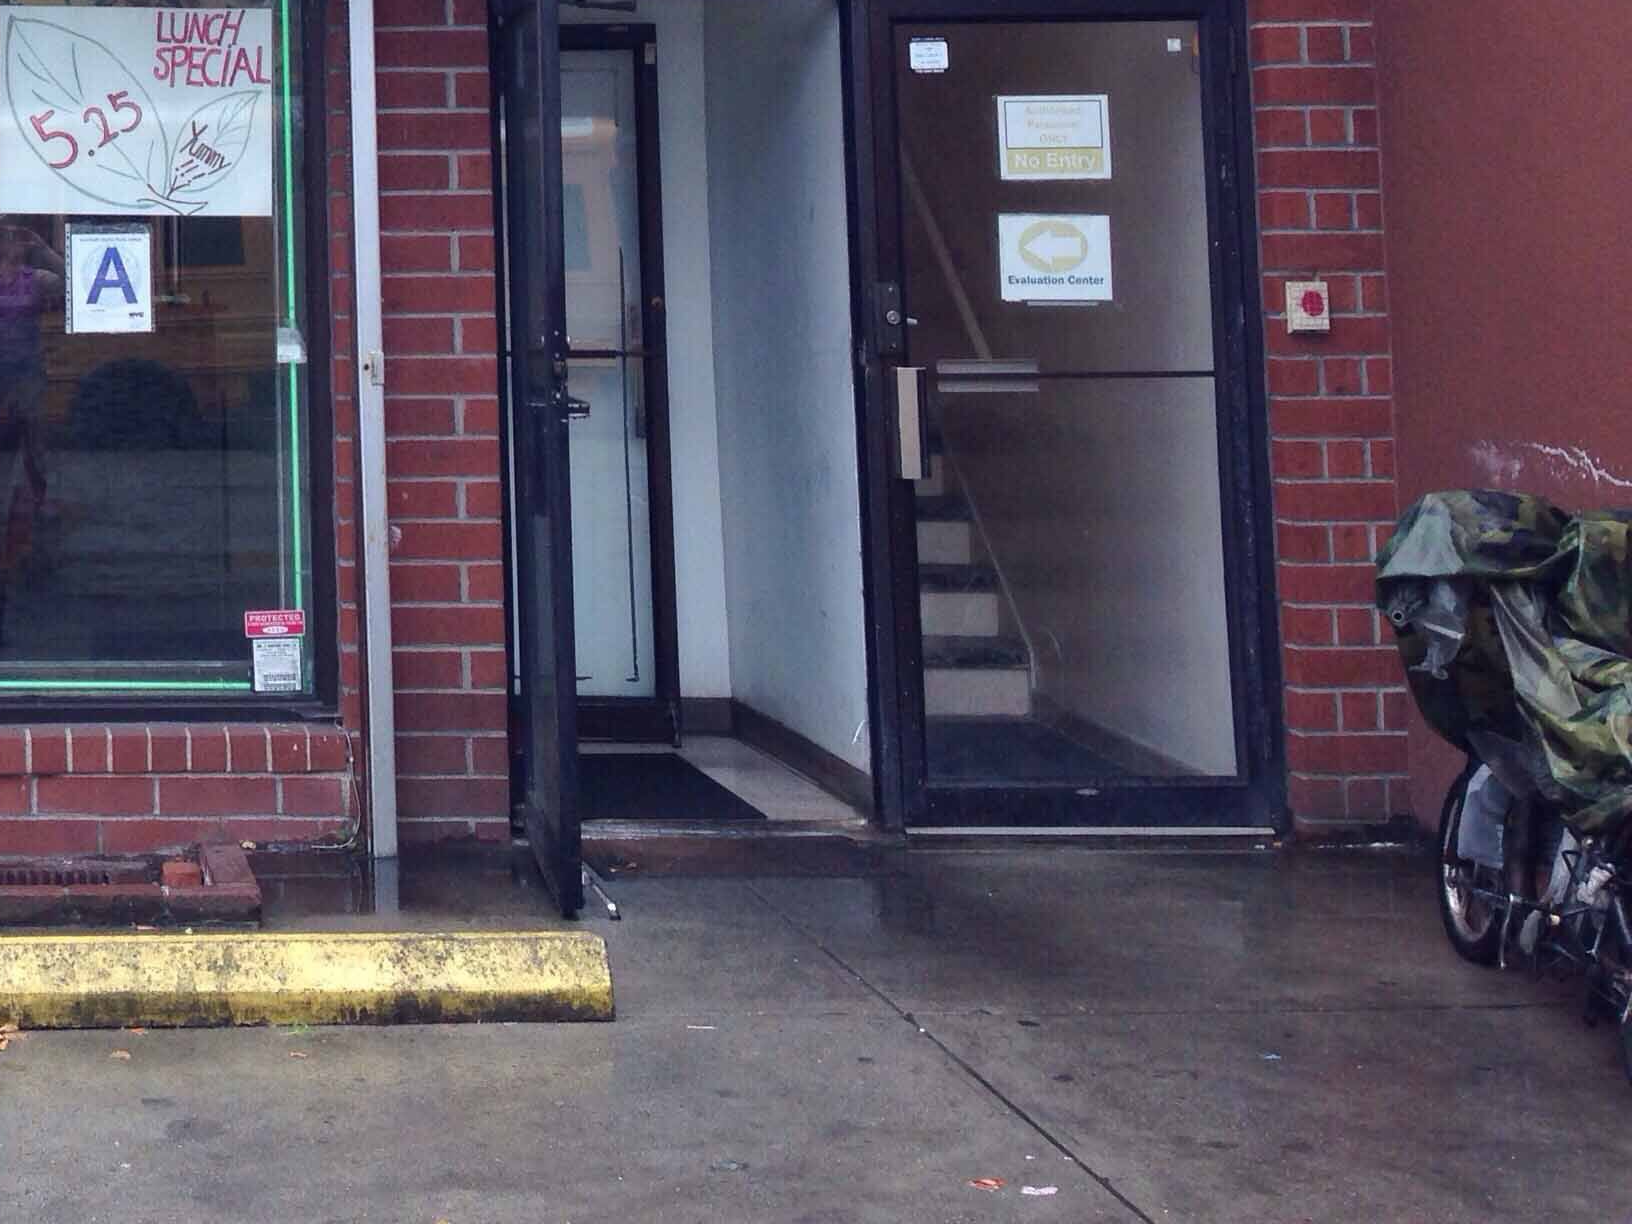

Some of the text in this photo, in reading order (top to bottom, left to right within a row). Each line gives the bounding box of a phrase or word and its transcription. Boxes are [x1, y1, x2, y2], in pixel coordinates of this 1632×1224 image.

[156, 9, 246, 46] LUNCH
[29, 90, 143, 169] 5.25
[1015, 152, 1096, 173] No Entry
[86, 247, 138, 305] A
[1008, 275, 1105, 286] Evaluation Center
